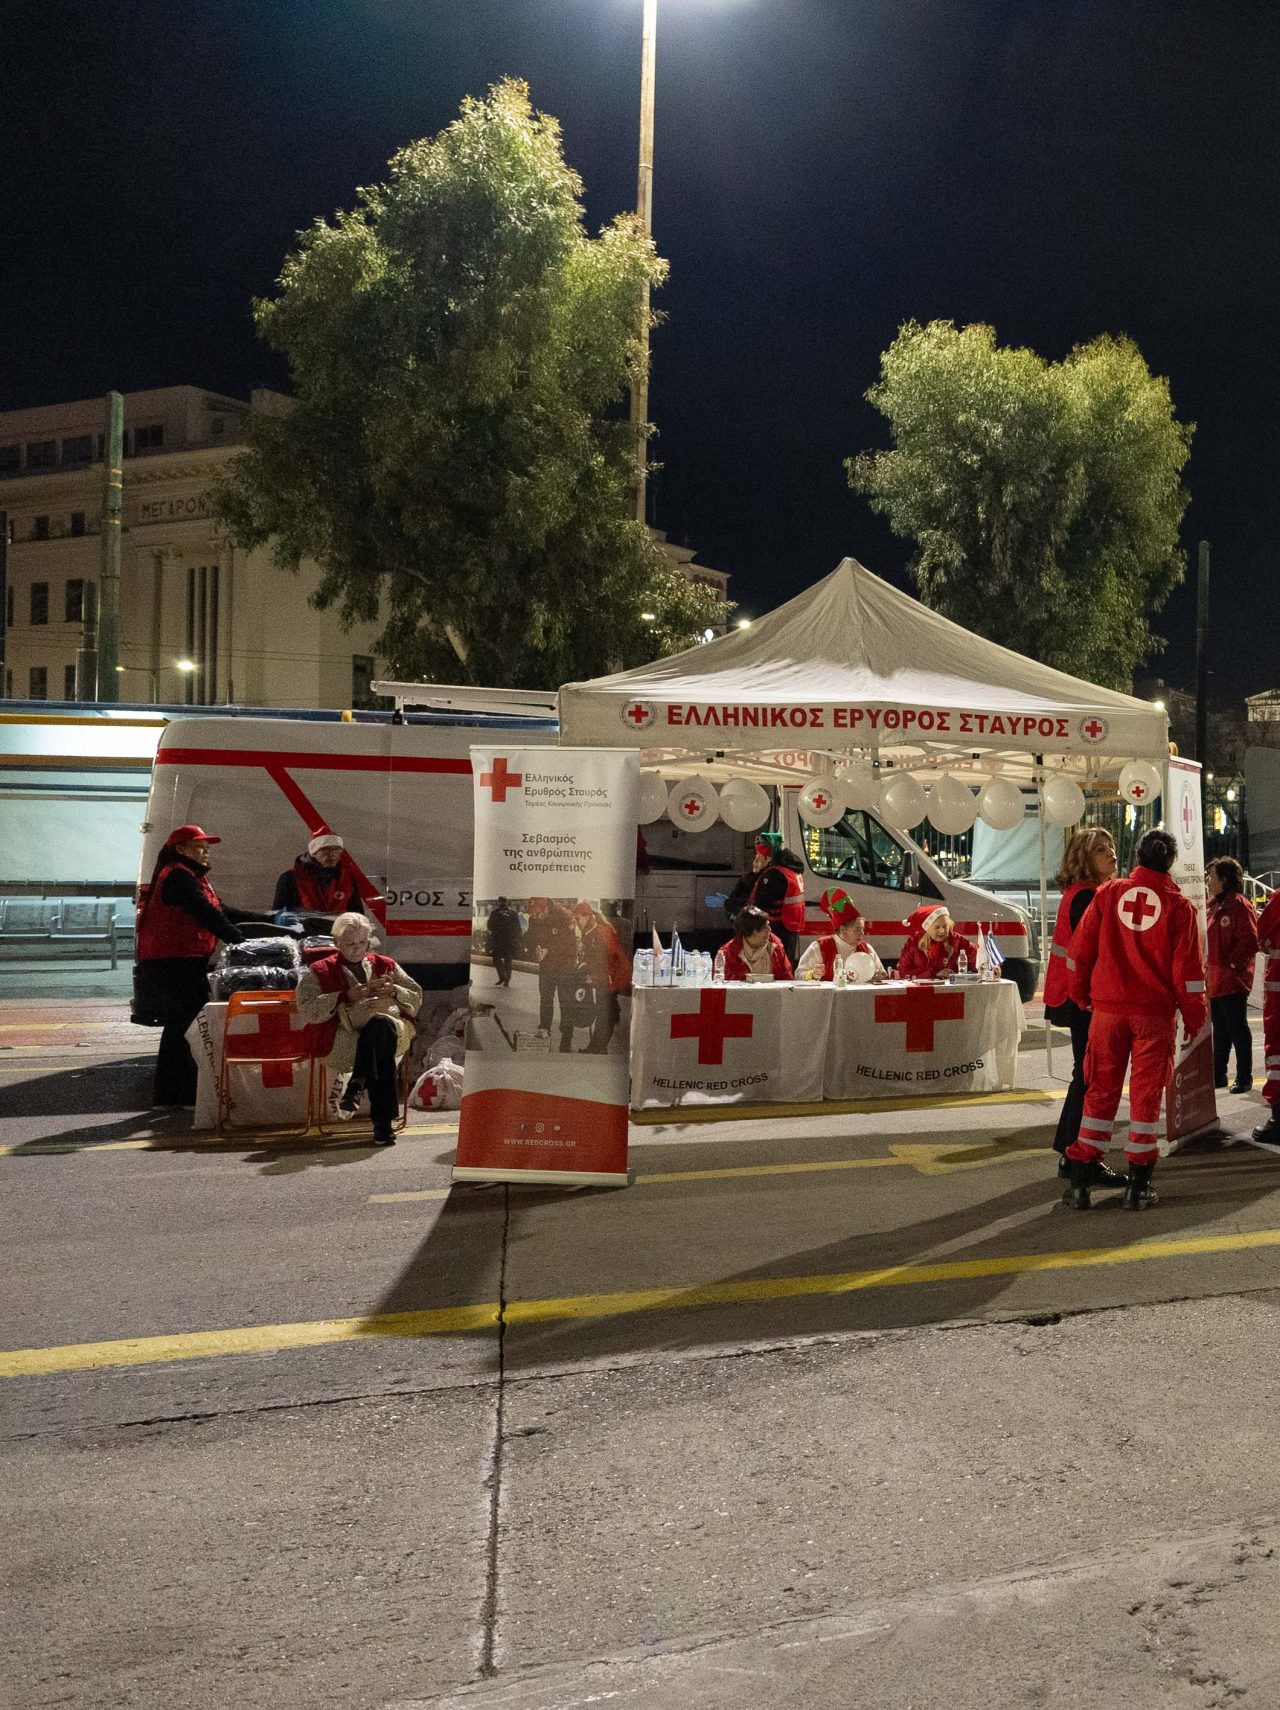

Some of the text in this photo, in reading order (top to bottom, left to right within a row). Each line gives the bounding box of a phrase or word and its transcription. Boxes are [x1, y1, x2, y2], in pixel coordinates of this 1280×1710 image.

[667, 704, 824, 728] ΕΛΛΗΝΙΚΟΣ
[833, 708, 950, 731] ΕΡΥΘΡΟΣ
[959, 713, 1068, 737] ΣΤΑΥΡΟΣ
[525, 773, 574, 784] Ελληνικός
[524, 787, 608, 798] Ερυθρός Σταυρός
[522, 833, 576, 845] Σεβασμός
[503, 847, 592, 859] της ανθρώπινης
[509, 861, 585, 873] αξιοπρέπειας
[855, 1059, 984, 1081] HELLENIC RED CROSS
[653, 1072, 769, 1090] HELLENIC RED CROSS
[503, 1138, 576, 1147] WWW.REDCROSS.GR
